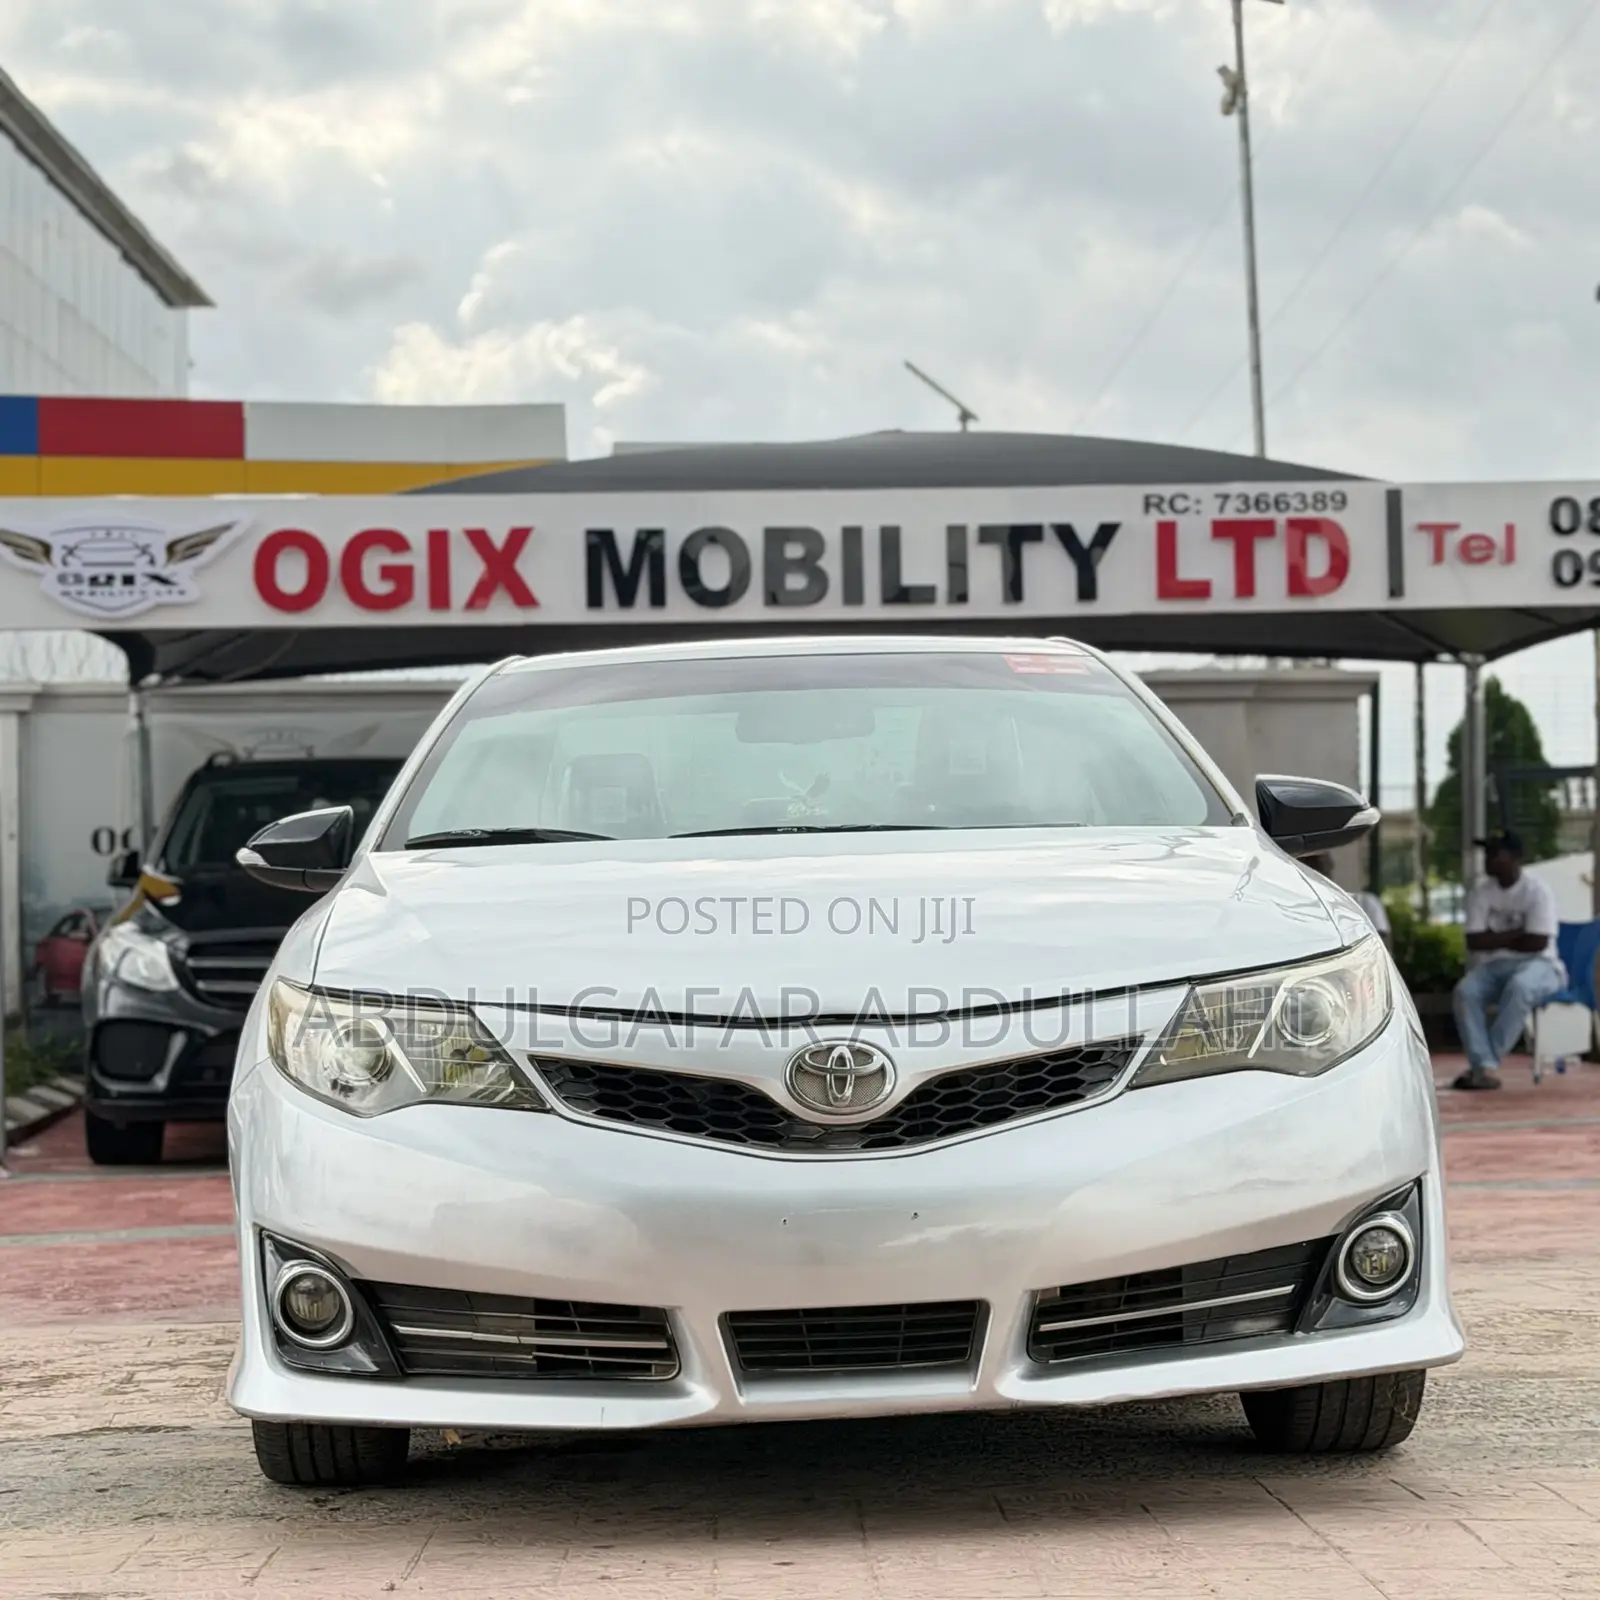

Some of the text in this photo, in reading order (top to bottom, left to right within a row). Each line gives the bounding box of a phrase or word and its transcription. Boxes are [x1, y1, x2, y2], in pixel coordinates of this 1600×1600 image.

[1143, 491, 1348, 515] RC: 7366389
[253, 517, 1351, 613] OGIX MOBILITY LTD
[1415, 522, 1517, 567] Tel
